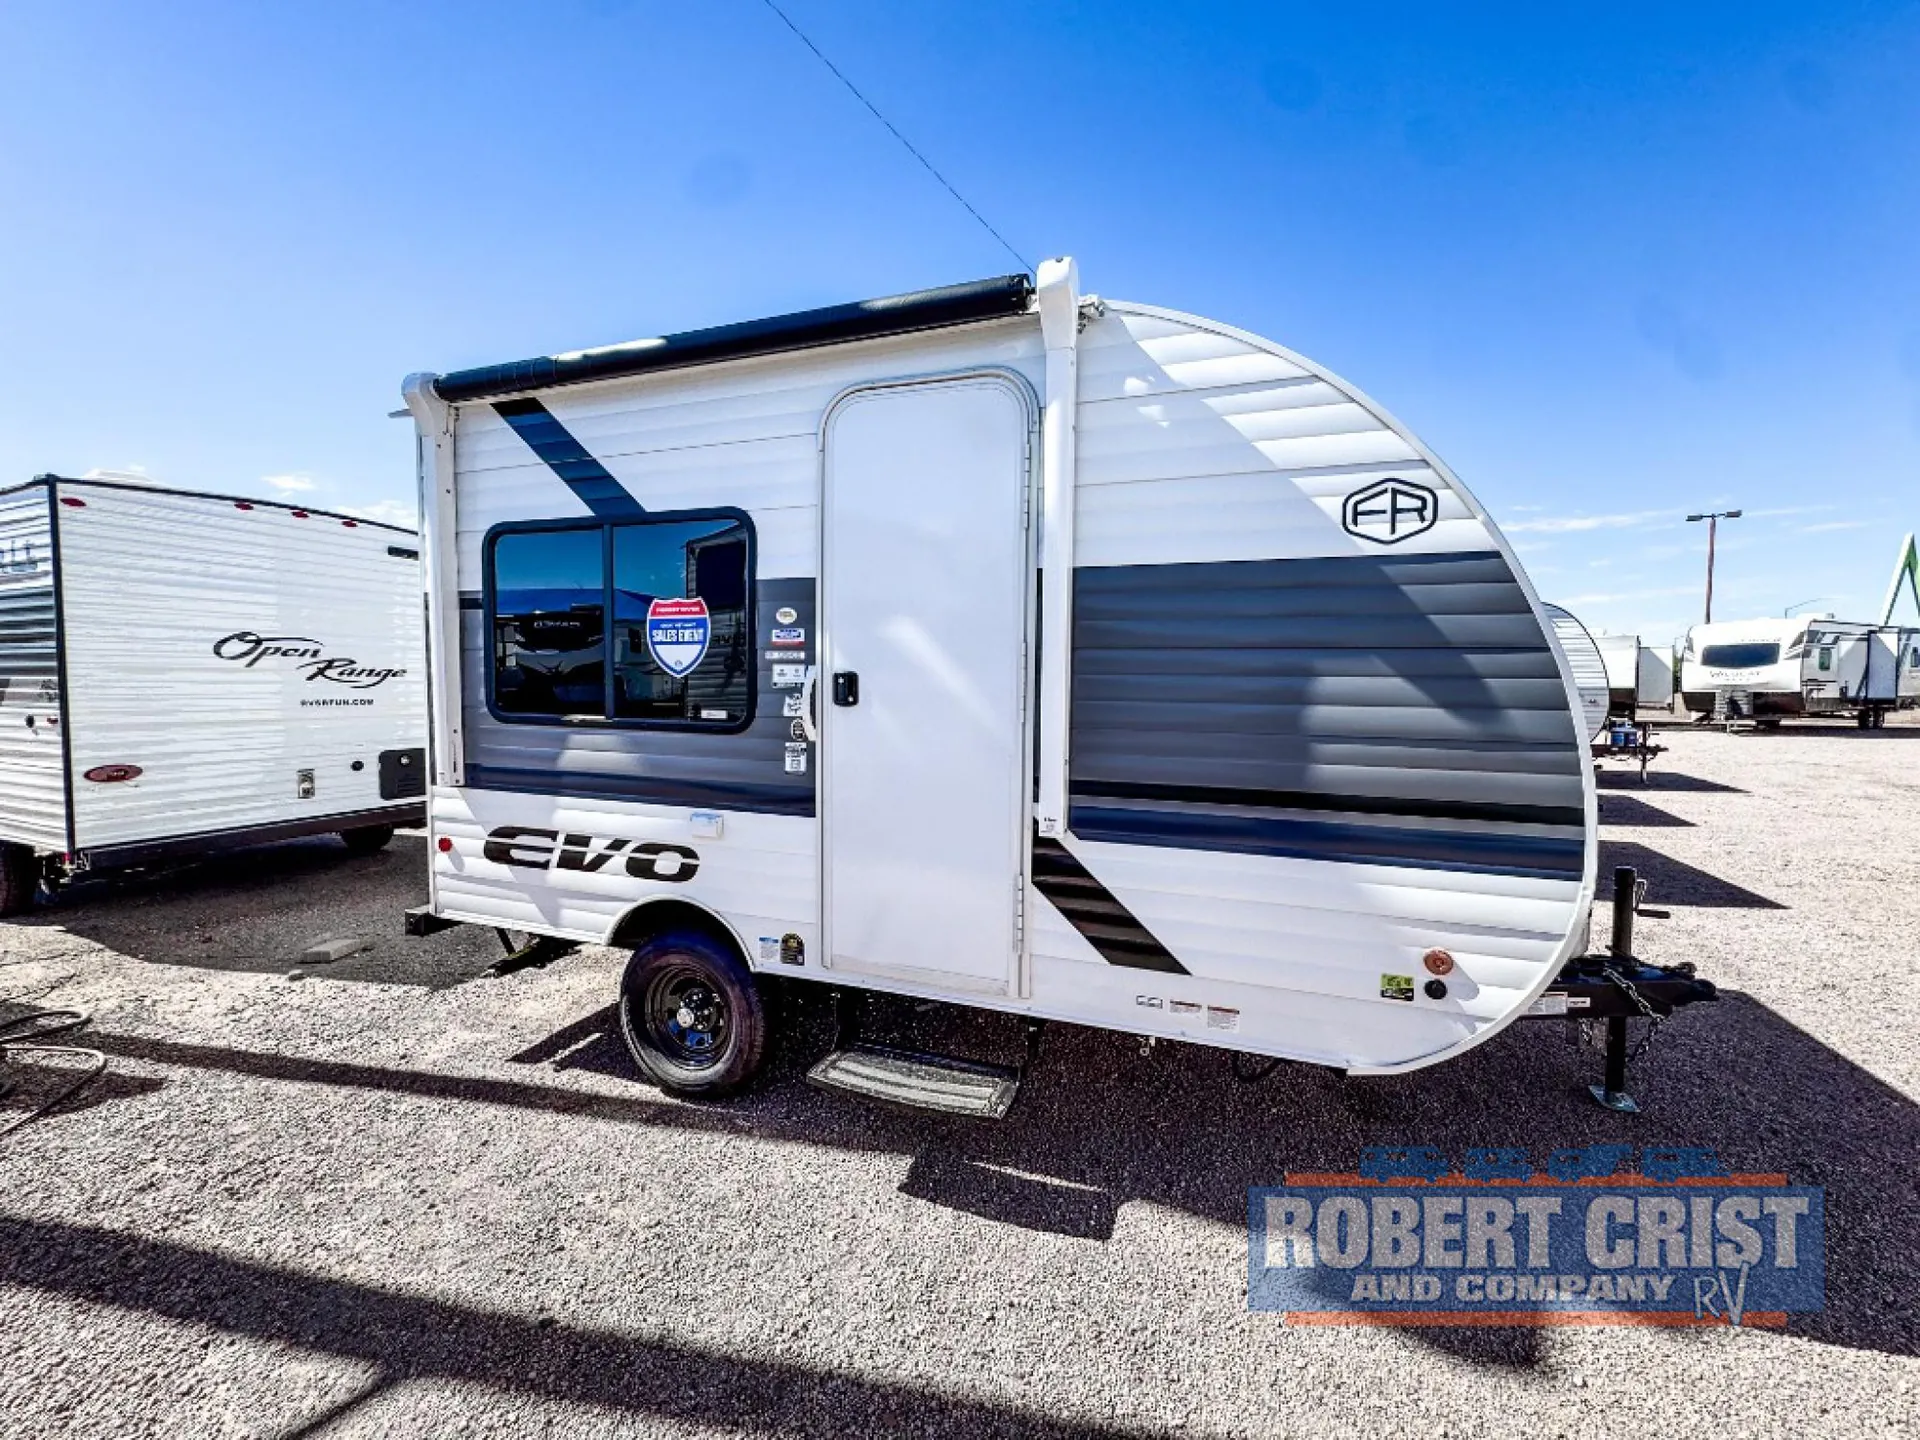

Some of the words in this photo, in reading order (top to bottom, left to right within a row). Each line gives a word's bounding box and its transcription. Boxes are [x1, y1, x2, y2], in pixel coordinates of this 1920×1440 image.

[213, 631, 326, 668] Open
[652, 629, 677, 642] SALES
[678, 628, 704, 642] EVENT
[296, 657, 408, 689] Range
[483, 825, 701, 883] EVO
